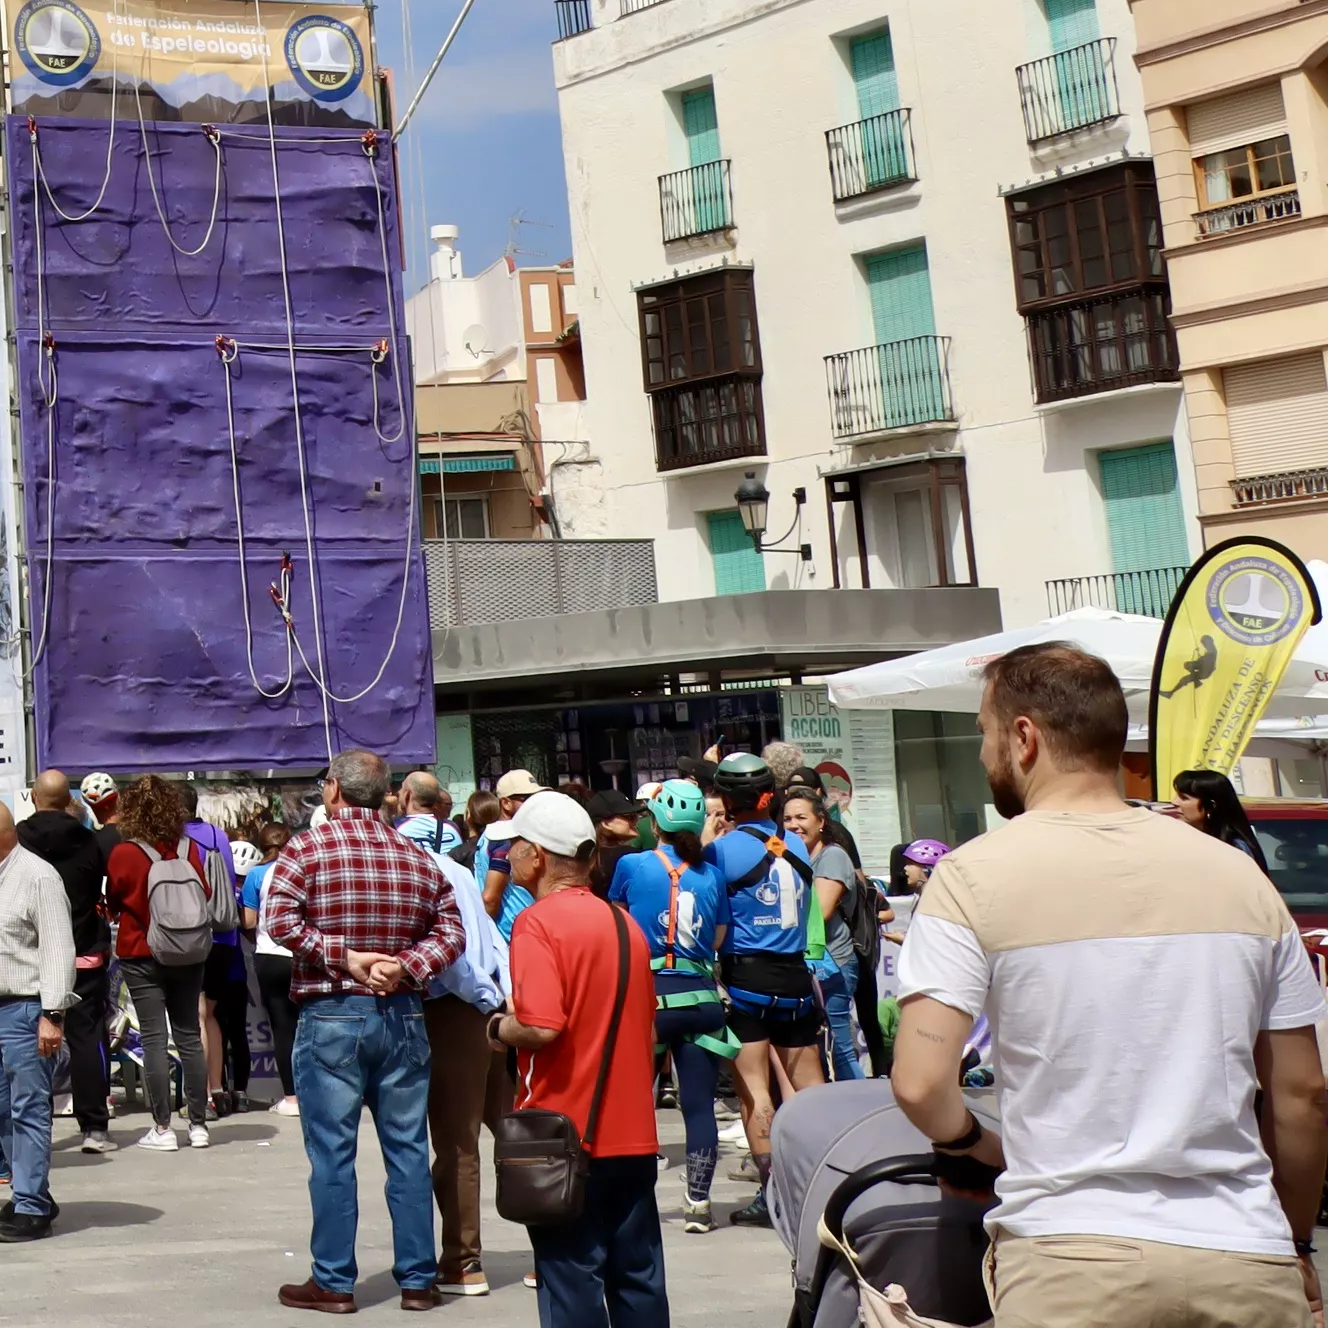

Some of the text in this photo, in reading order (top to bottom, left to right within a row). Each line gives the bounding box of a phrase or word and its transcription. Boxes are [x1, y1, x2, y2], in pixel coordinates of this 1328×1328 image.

[106, 12, 268, 35] Federación Andaluza
[110, 28, 272, 60] de Espeleología
[48, 57, 66, 68] FAE
[319, 74, 336, 84] FAE
[1242, 617, 1262, 628] FAE
[1202, 682, 1242, 758] ANDALUZA
[1238, 657, 1255, 678] DE
[1222, 671, 1264, 739] DESCENSO
